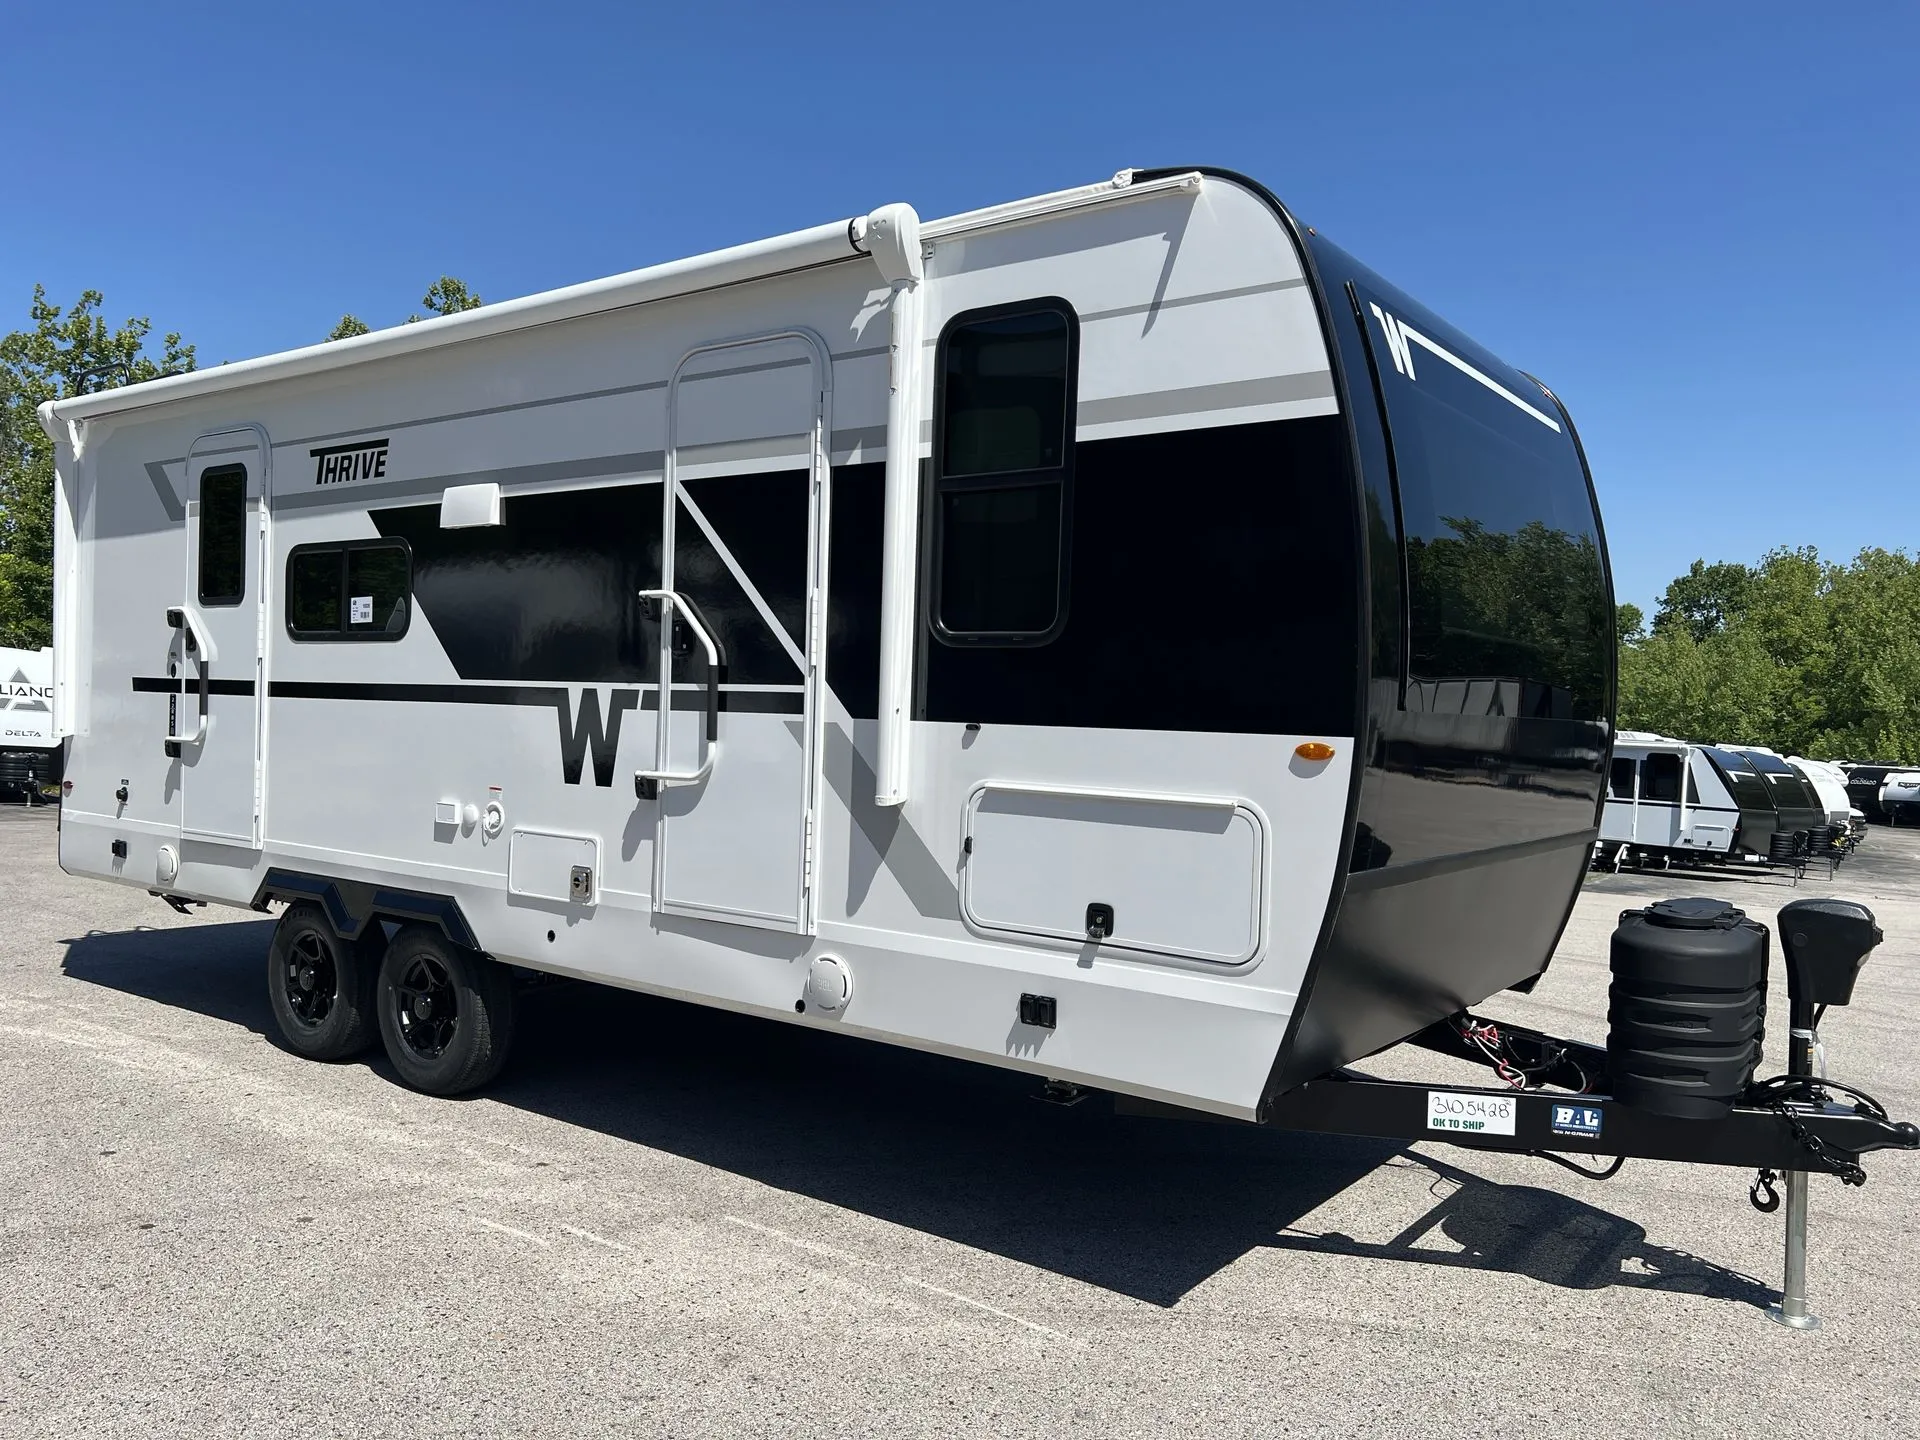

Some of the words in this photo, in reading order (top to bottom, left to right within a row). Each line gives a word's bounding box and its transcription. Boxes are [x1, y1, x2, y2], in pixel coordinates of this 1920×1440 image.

[310, 438, 390, 485] THRIVE
[1432, 1117, 1446, 1127] OK
[1448, 1119, 1460, 1129] TO
[1462, 1120, 1485, 1130] SHIP
[1555, 1107, 1599, 1126] BAL
